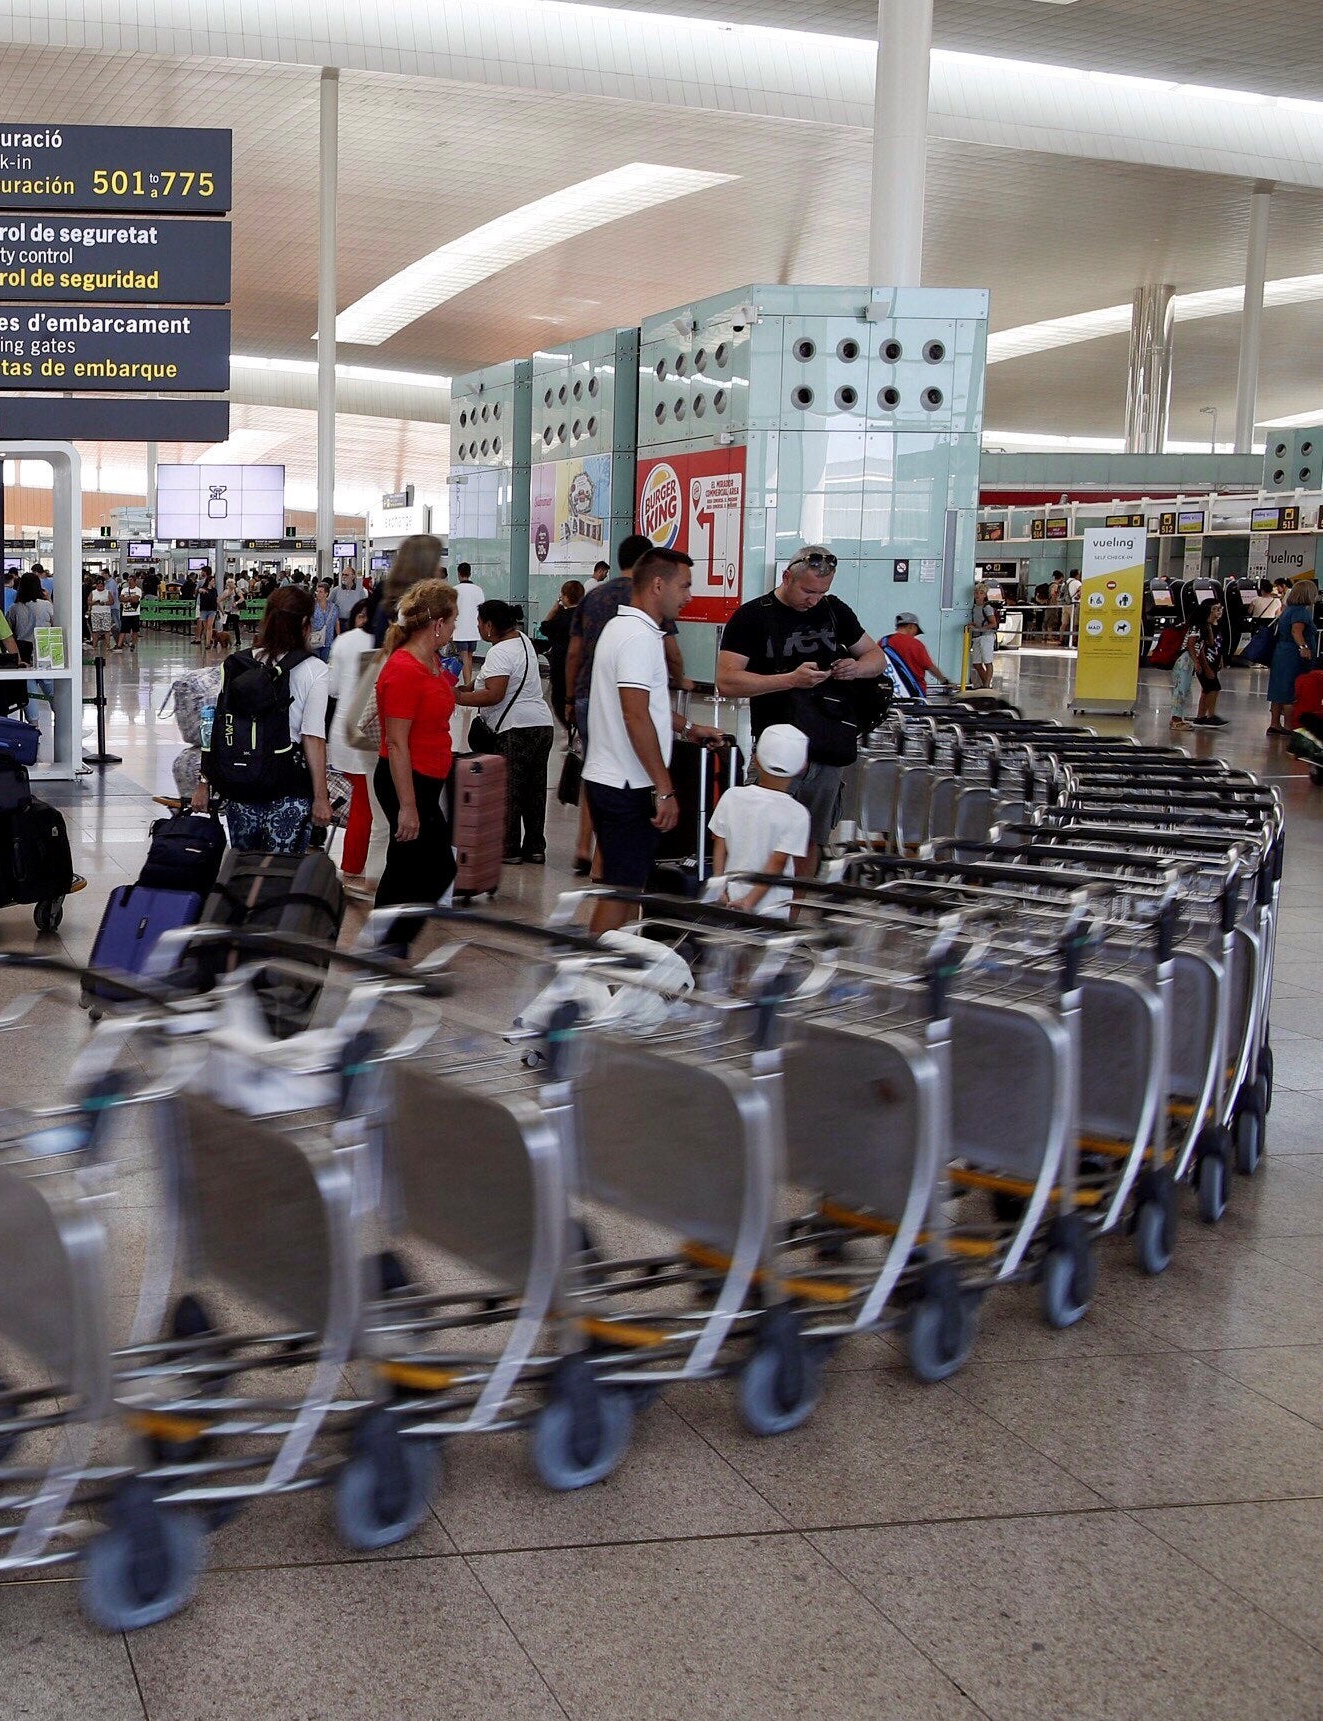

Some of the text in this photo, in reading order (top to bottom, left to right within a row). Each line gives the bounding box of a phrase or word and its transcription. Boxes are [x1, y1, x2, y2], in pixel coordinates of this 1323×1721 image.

[93, 171, 144, 194] 501
[161, 172, 213, 196] 775
[31, 223, 54, 242] de
[60, 227, 157, 246] seguretat
[19, 248, 72, 263] control
[31, 269, 54, 286] de
[60, 270, 158, 291] seguridad
[28, 313, 190, 333] d'embarcament
[31, 338, 75, 356] gates
[41, 359, 65, 376] de
[74, 360, 176, 381] embarque
[645, 480, 676, 515] BURGER
[645, 495, 677, 537] KING
[1282, 521, 1295, 529] 511
[1093, 537, 1134, 549] vueling
